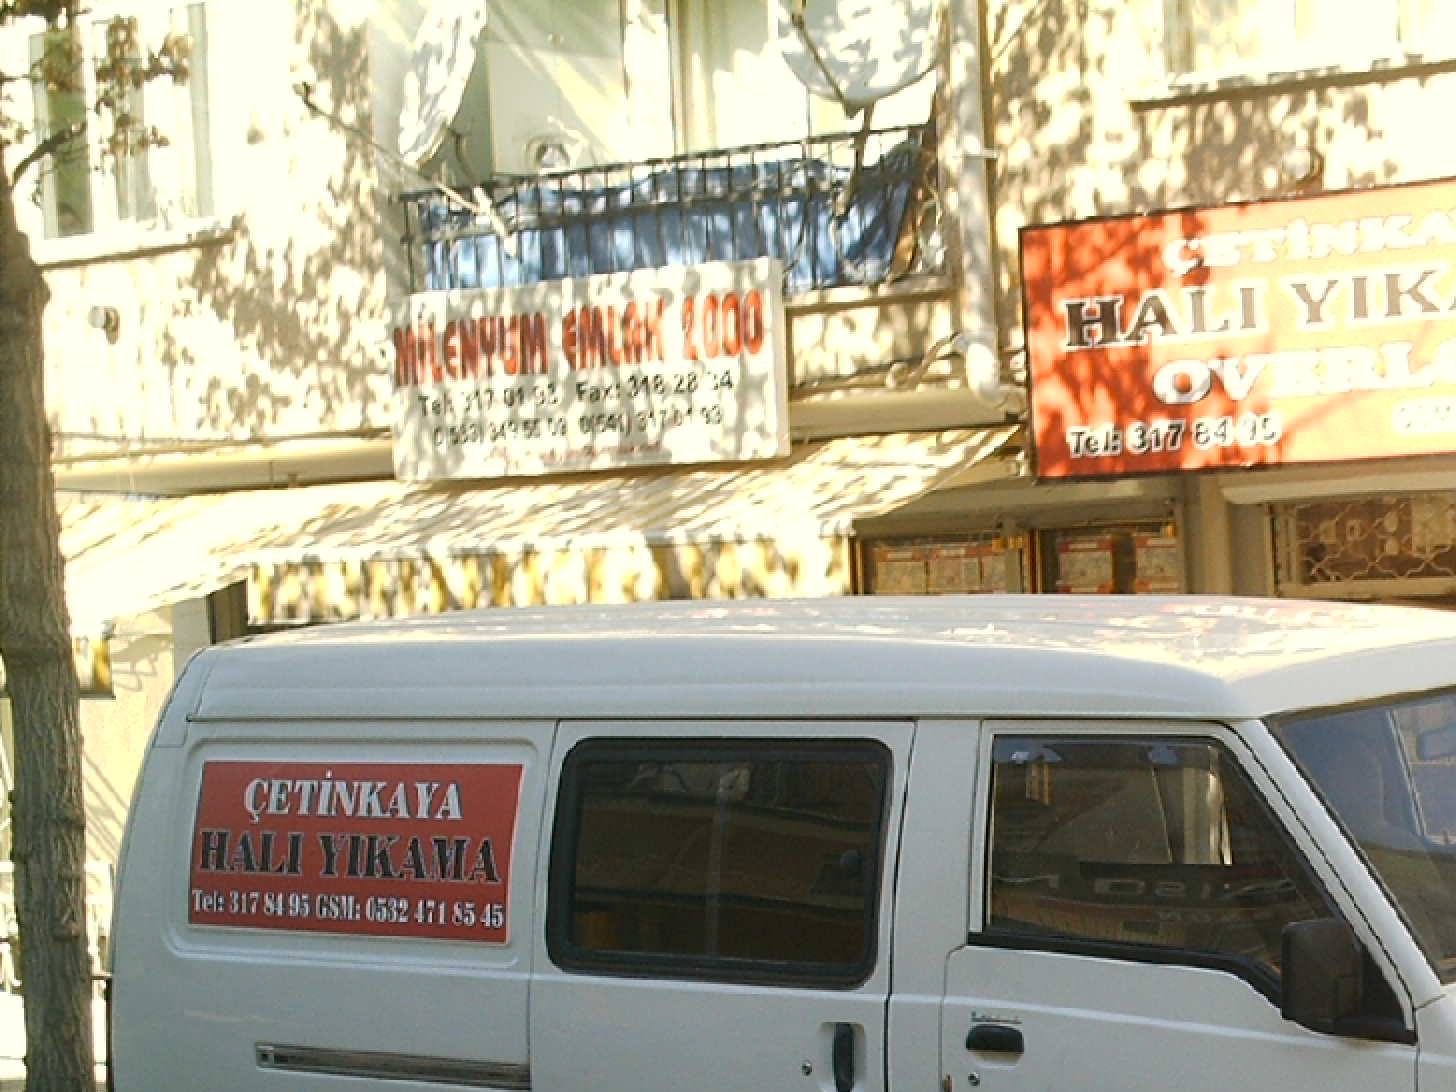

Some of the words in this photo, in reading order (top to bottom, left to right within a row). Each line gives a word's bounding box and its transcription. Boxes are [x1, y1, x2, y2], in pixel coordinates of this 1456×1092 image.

[682, 290, 765, 360] 2000
[1060, 283, 1264, 350] HALI
[673, 371, 699, 394] 28
[1067, 423, 1121, 457] Tel:
[1127, 419, 1185, 452] 317
[1191, 415, 1235, 448] 84
[244, 769, 464, 824] ÇETİNKAYA
[200, 827, 303, 875] HALI
[317, 832, 500, 884] YIKAMA
[192, 889, 224, 913] Tel:
[230, 890, 259, 914] 317
[263, 891, 283, 916] 84
[288, 892, 310, 917] 95
[315, 894, 360, 920] GSM:
[414, 898, 448, 924] 471
[481, 903, 504, 929] 45
